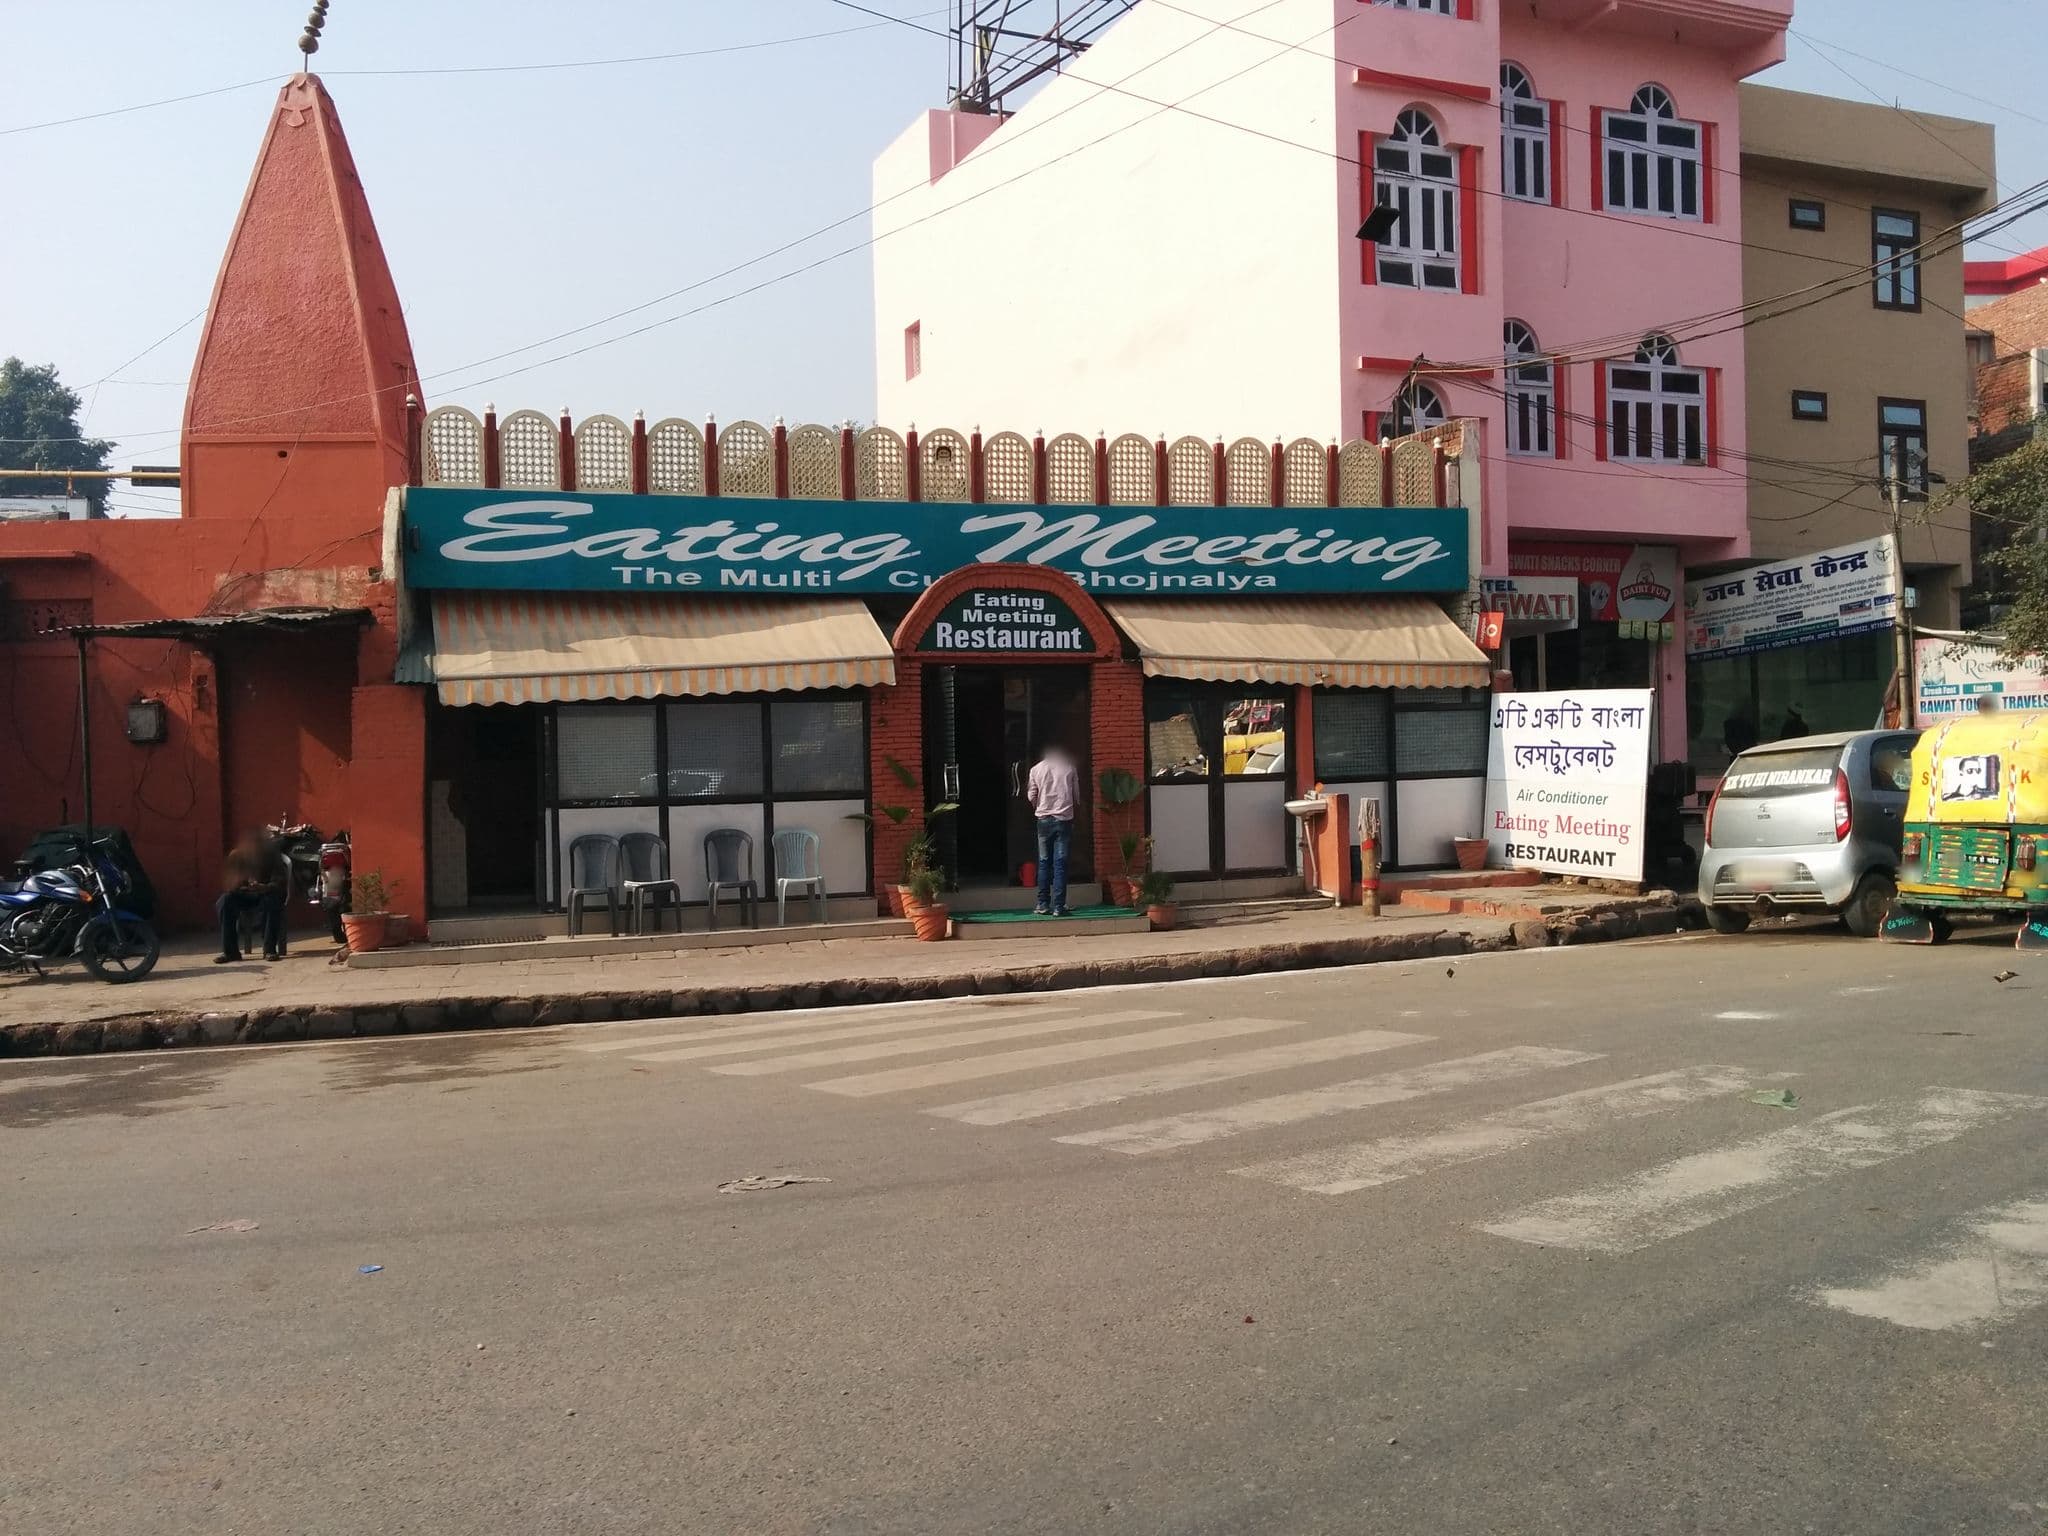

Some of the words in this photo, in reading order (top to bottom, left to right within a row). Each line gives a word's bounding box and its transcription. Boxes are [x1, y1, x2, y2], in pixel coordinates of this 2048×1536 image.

[439, 500, 922, 581] Eating
[960, 511, 1450, 582] Meeting
[1542, 555, 1580, 572] SNACKS
[1582, 556, 1621, 573] CORNER
[612, 566, 702, 586] The
[721, 568, 832, 588] Multi
[1704, 579, 1745, 602] जन
[1754, 566, 1803, 592] सेवा
[1811, 550, 1868, 577] केन्द्र
[974, 593, 1045, 611] Eating
[962, 609, 1056, 627] Meeting
[936, 622, 1082, 649] Restaurant
[1494, 700, 1528, 729] এটি
[1532, 699, 1584, 729] একটি
[1591, 706, 1644, 729] বাংলা
[1920, 698, 1957, 713] RAWAT
[1739, 773, 1754, 788] TU
[1753, 772, 1767, 787] HI
[1767, 768, 1833, 787] NIRANKAR
[1922, 771, 1929, 785] S
[2021, 769, 2031, 783] K
[1517, 789, 1534, 802] Air
[1537, 790, 1608, 805] Conditioner
[1494, 810, 1549, 838] Eating
[1555, 814, 1631, 845] Meeting
[1505, 843, 1616, 867] RESTAURANT
